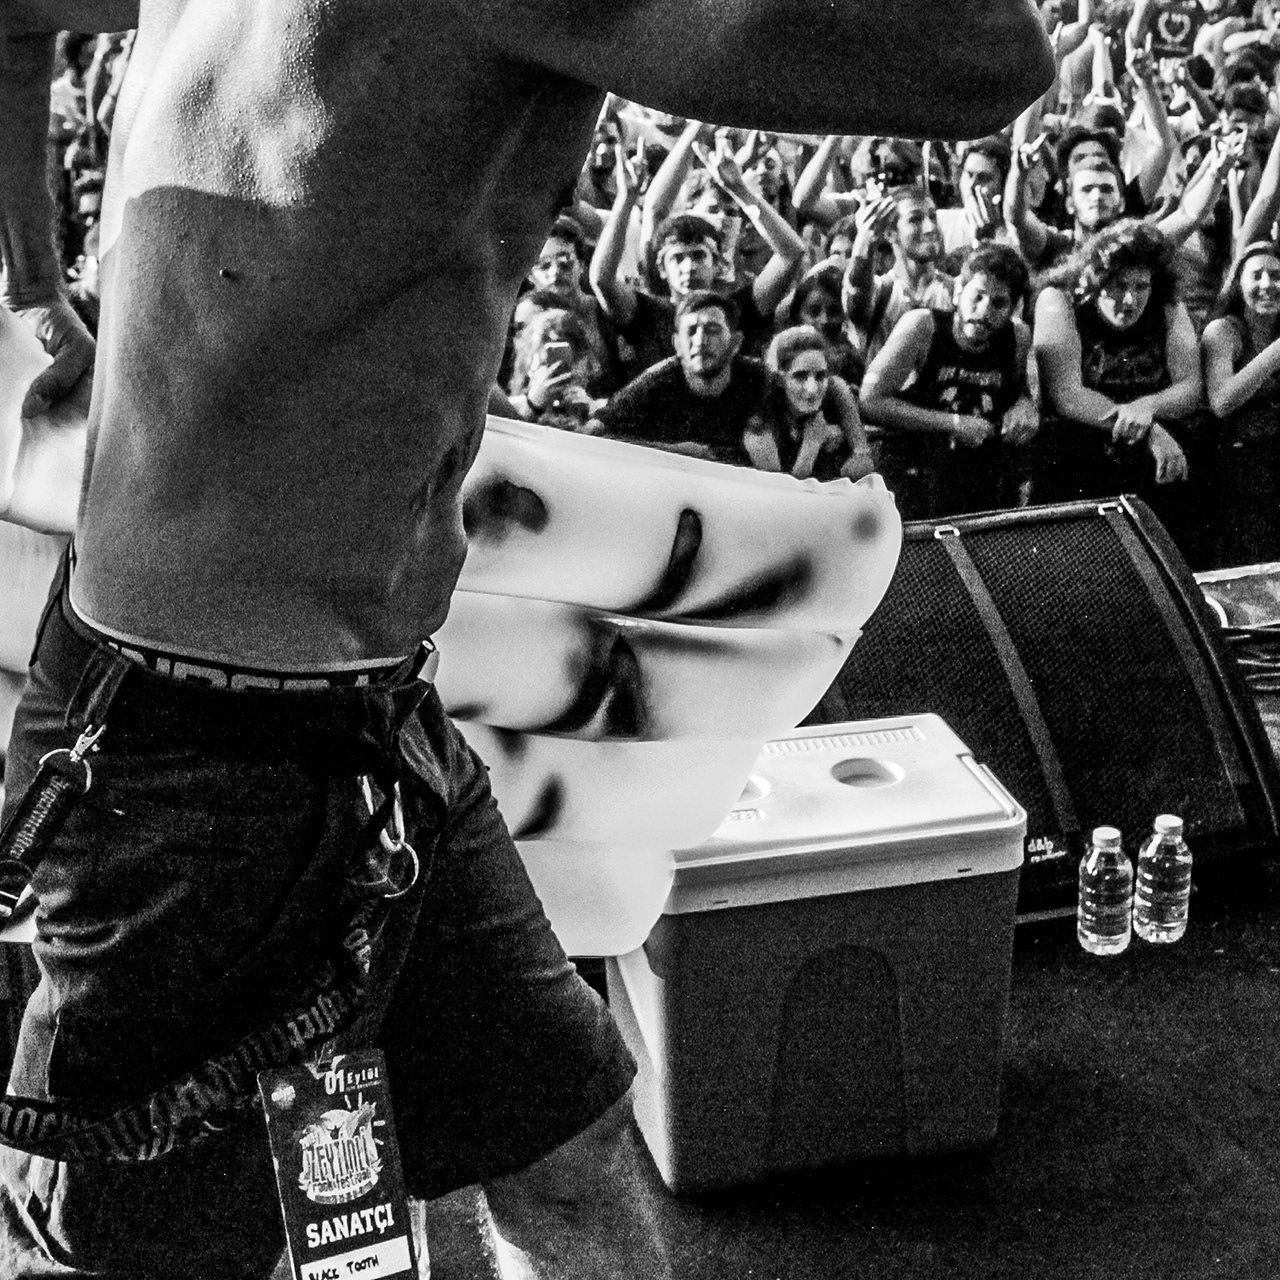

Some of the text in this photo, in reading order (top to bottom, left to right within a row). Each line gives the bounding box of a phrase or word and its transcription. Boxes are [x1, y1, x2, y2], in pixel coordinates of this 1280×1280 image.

[325, 1069, 345, 1095] 01
[306, 1203, 395, 1248] SANATÇI
[346, 1255, 379, 1274] TOOTH
